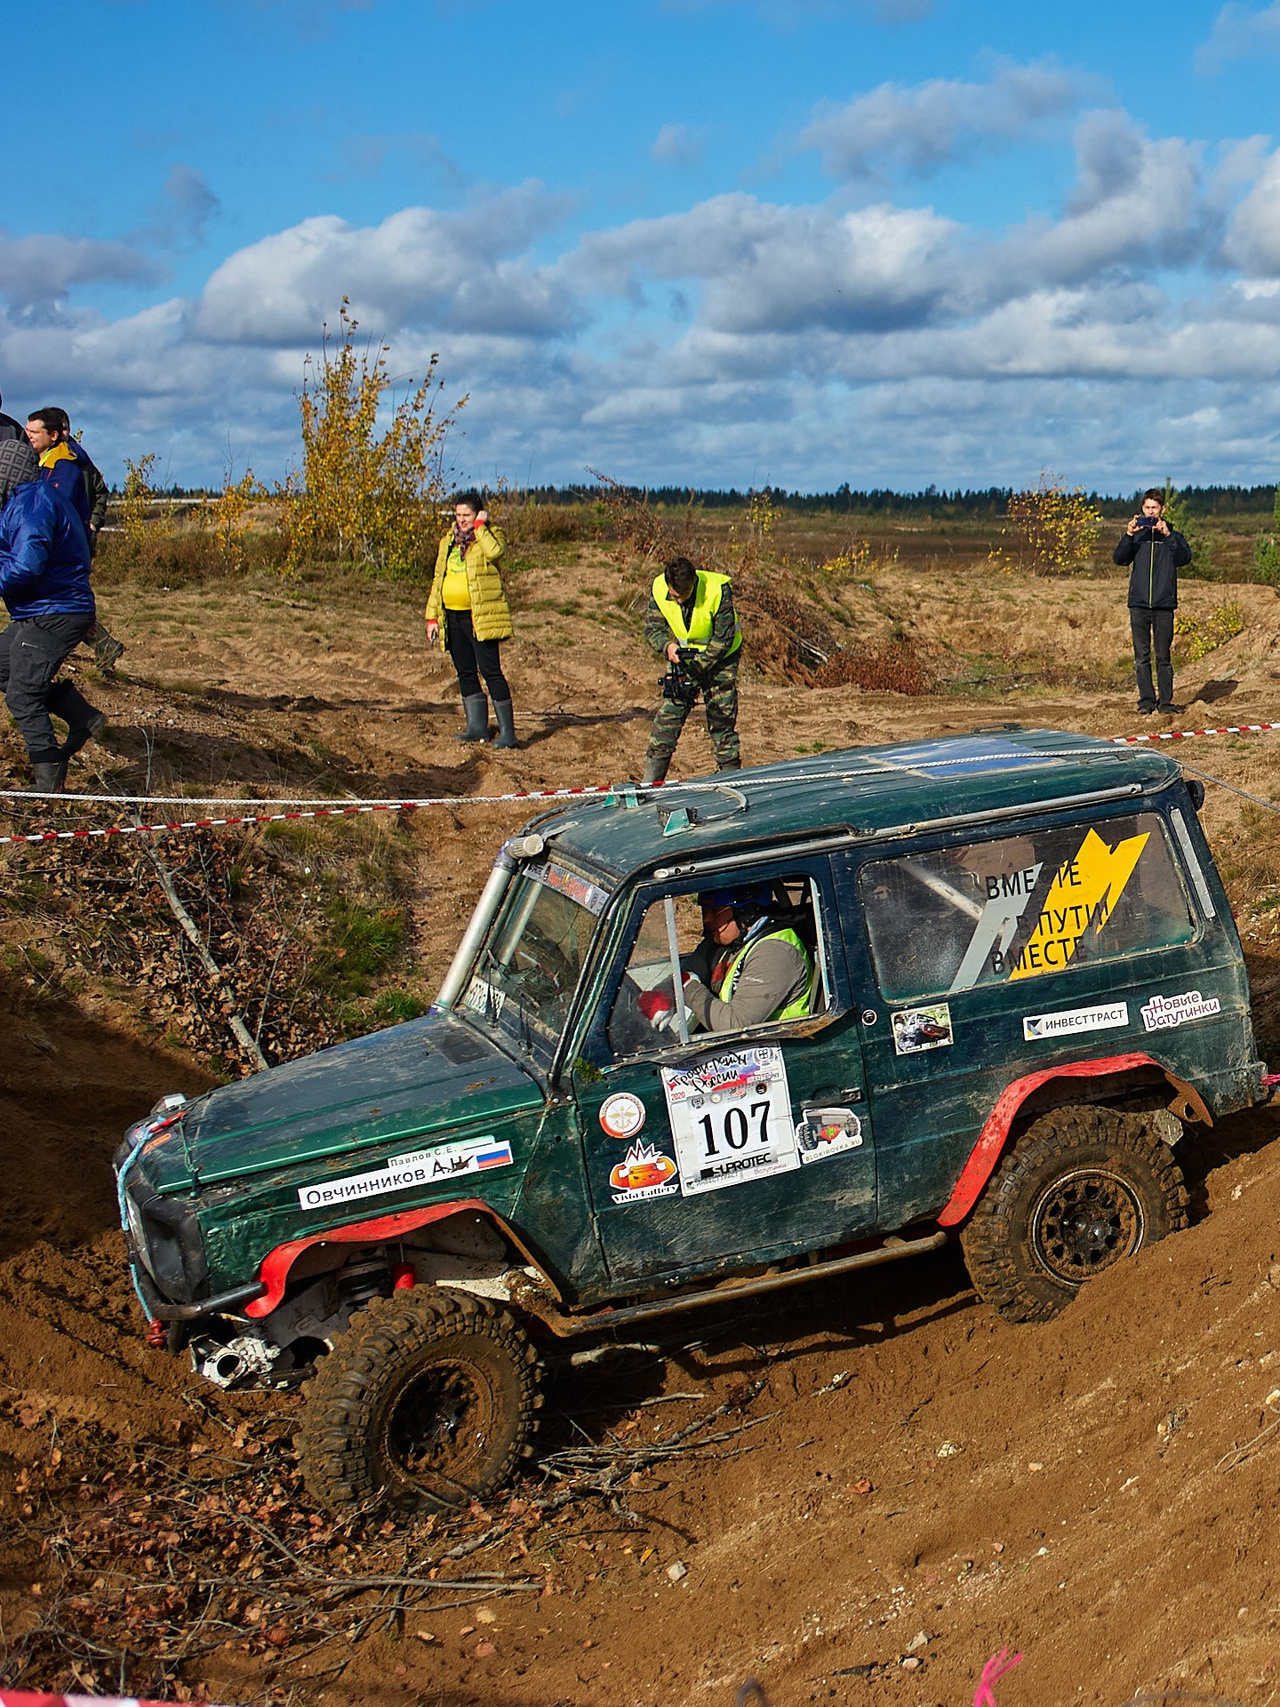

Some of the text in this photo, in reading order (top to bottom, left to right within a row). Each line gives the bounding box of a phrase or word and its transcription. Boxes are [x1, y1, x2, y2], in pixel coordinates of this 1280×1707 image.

[1145, 991, 1200, 1015] Новые
[1045, 1010, 1124, 1030] ИНВЕСТТРАСТ
[1145, 1001, 1219, 1030] Ватутинки
[671, 1091, 686, 1101] 2020
[698, 1100, 771, 1157] 107
[390, 1145, 458, 1168] Павлов С.Е.
[805, 1139, 861, 1162] BLOKIROVKA.RU
[306, 1168, 426, 1206] Овчинников
[613, 1193, 639, 1203] Vista
